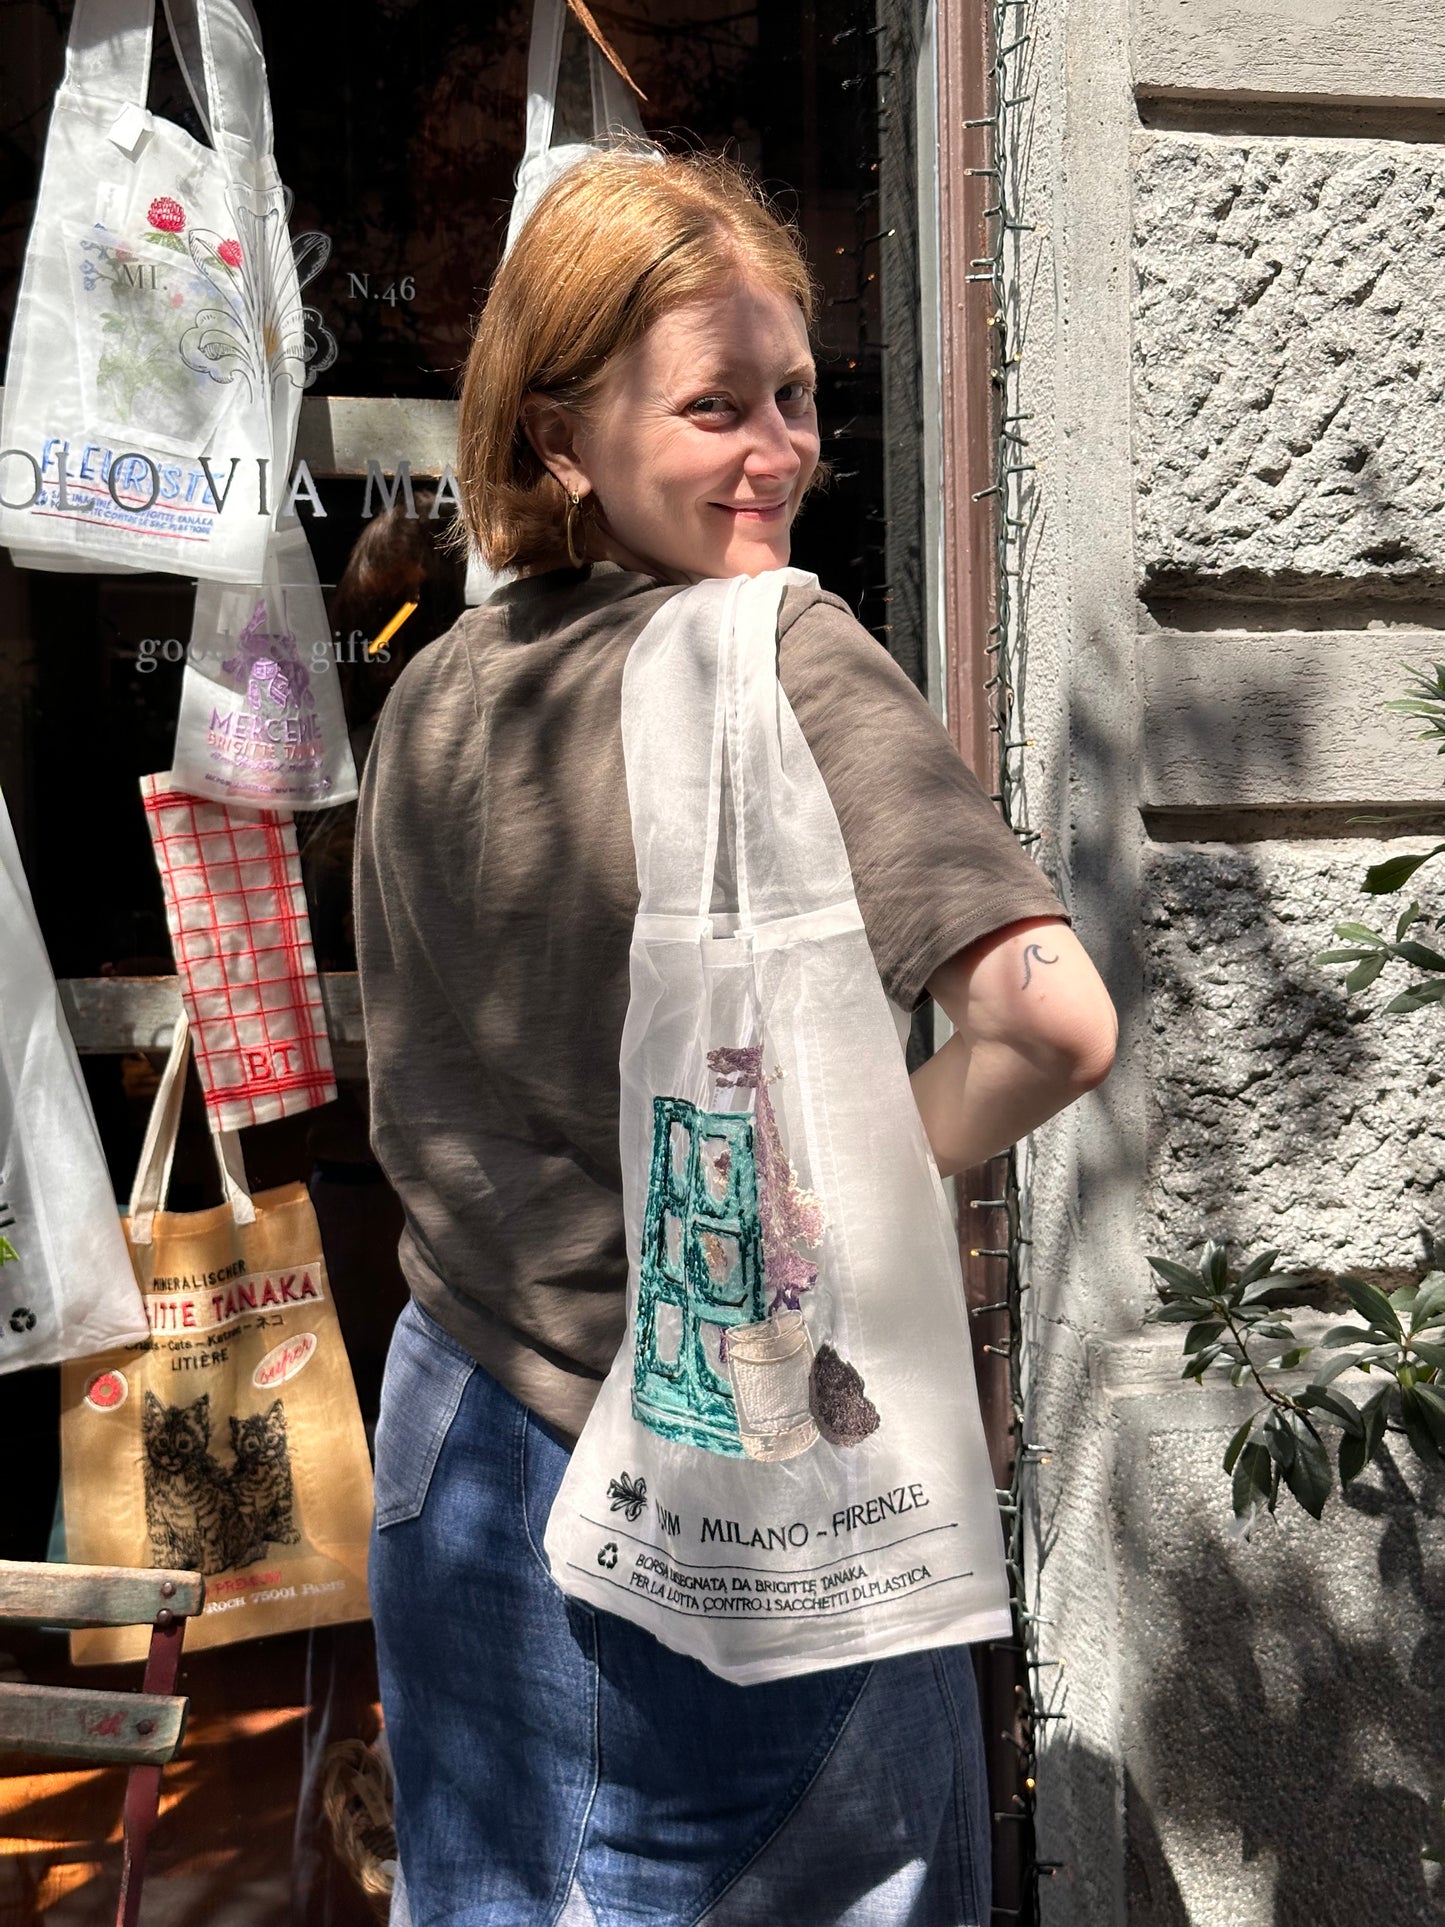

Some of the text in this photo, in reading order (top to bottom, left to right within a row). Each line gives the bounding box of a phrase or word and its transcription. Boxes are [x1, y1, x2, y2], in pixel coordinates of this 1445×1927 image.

[122, 264, 168, 291] MI.
[346, 271, 417, 308] N.46
[198, 456, 328, 518] VIA
[310, 629, 392, 674] gifts
[246, 1042, 297, 1081] BT
[153, 1259, 246, 1291] MINERALISCHER
[212, 1271, 318, 1322] TANAKA
[171, 1348, 230, 1372] LITIÈRE
[700, 1516, 809, 1551] MILANO
[832, 1483, 930, 1538] FIRENZE
[629, 1571, 650, 1595] PER
[650, 1580, 666, 1600] LA
[666, 1587, 699, 1610] LOTTA
[702, 1597, 762, 1613] CONTRO
[774, 1590, 850, 1612] SACCHETTI
[868, 1565, 932, 1596] PLASTICA
[635, 1553, 669, 1579] BORSA
[732, 1577, 752, 1592] DA
[755, 1578, 817, 1595] BRIGITTE
[820, 1564, 868, 1591] TANAKA
